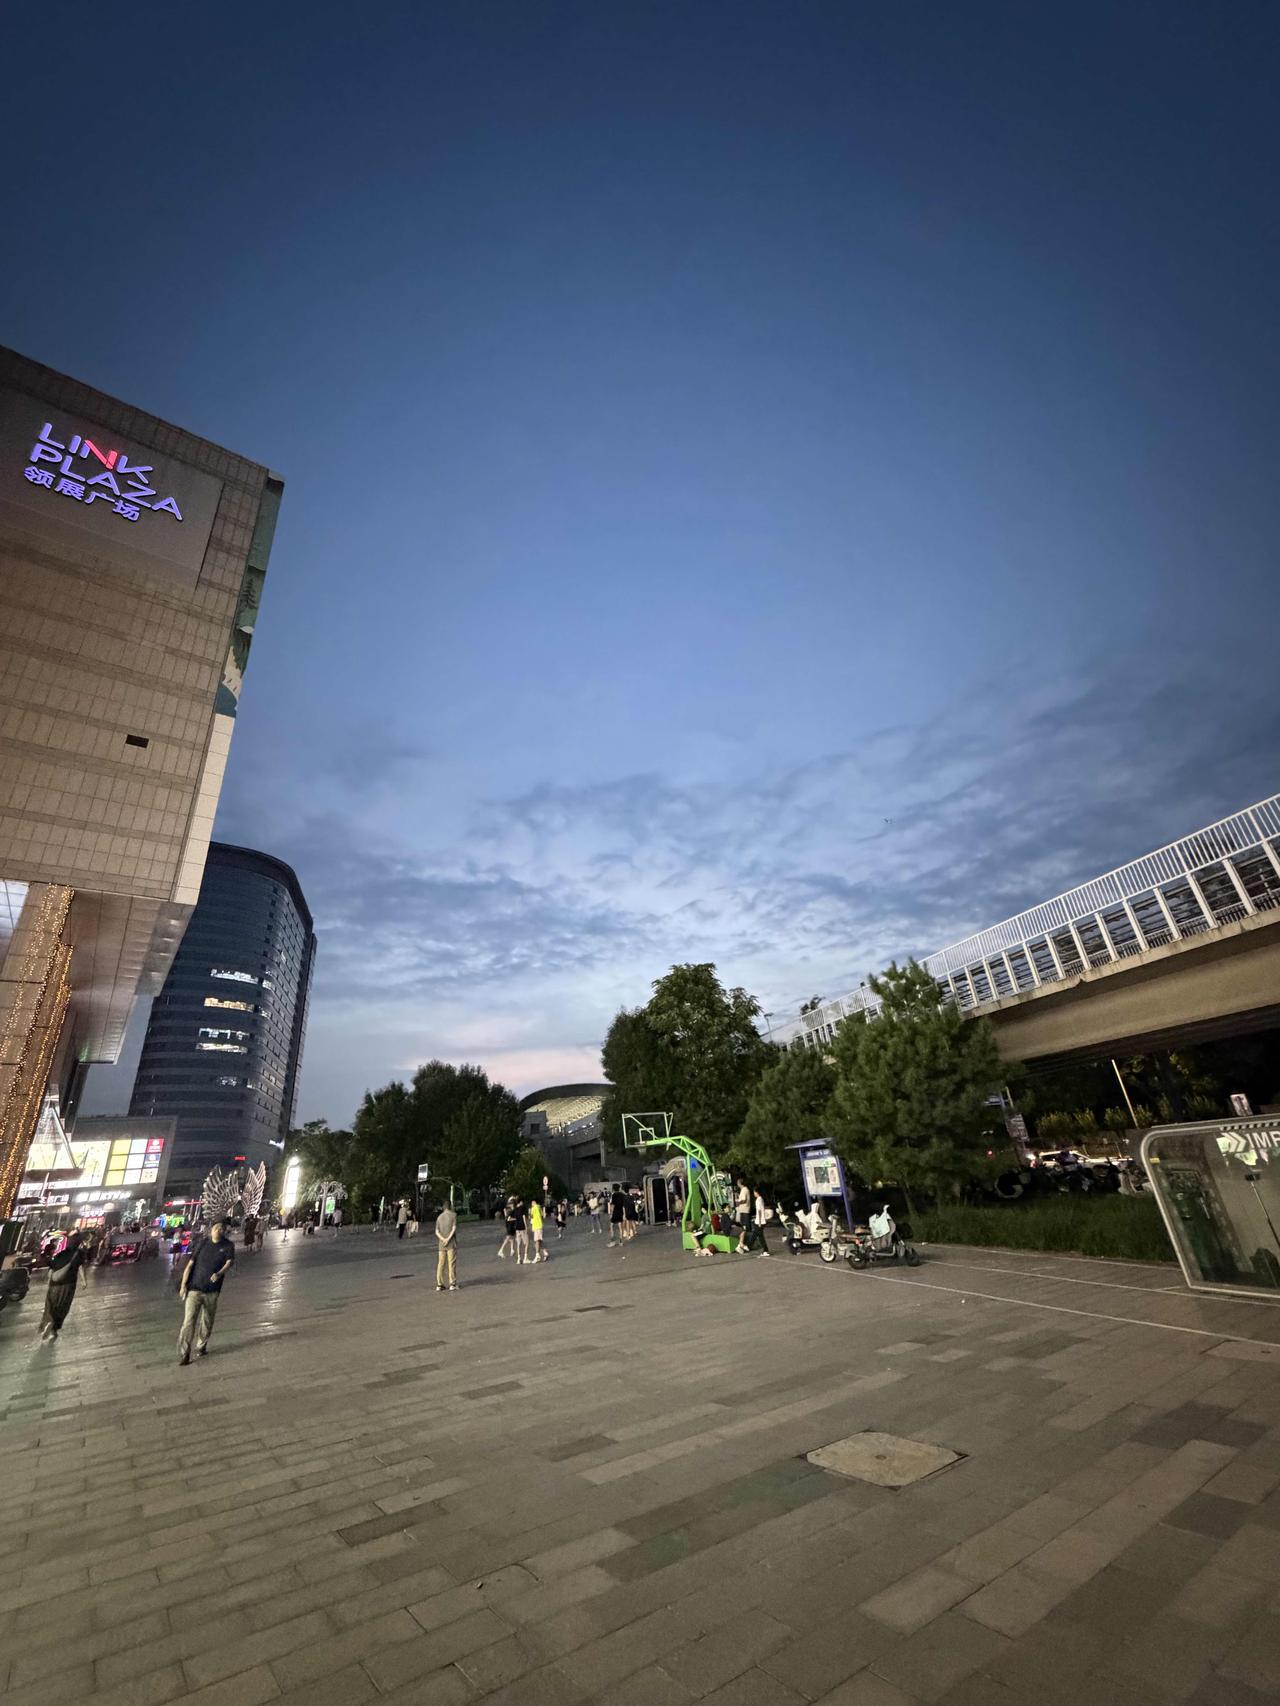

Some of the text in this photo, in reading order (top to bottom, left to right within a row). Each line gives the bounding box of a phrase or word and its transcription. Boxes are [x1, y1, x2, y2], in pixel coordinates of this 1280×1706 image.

[29, 443, 183, 521] PLAZA
[38, 422, 153, 484] LINK
[23, 466, 141, 522] 领展广场
